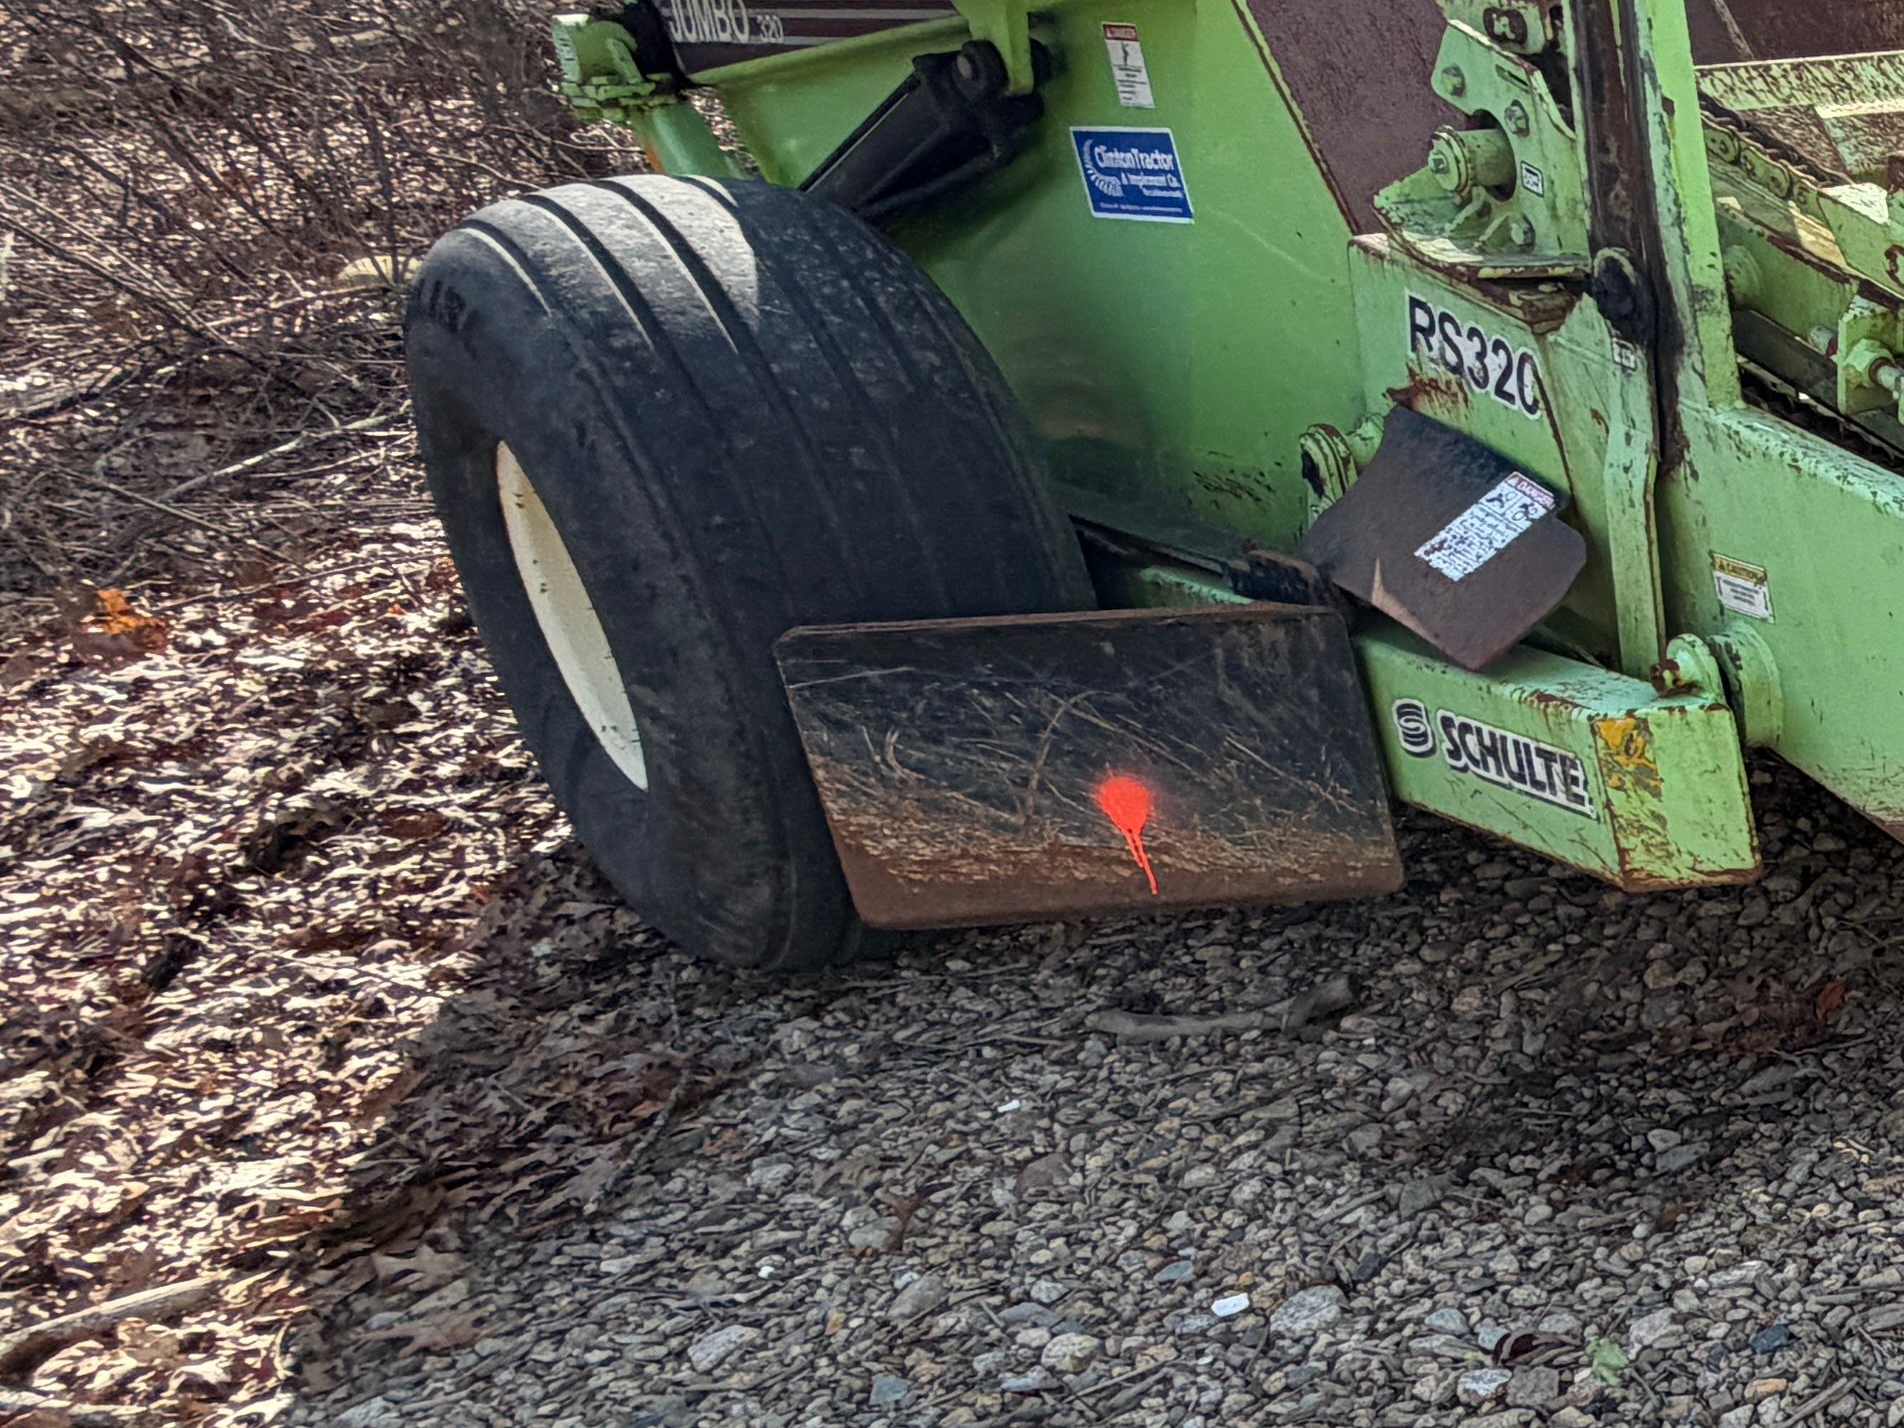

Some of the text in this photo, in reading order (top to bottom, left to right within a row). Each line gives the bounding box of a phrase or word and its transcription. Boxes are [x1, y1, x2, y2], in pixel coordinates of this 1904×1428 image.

[757, 14, 784, 44] 320
[1409, 295, 1544, 415] RS320
[1440, 714, 1586, 808] SCHULTE
